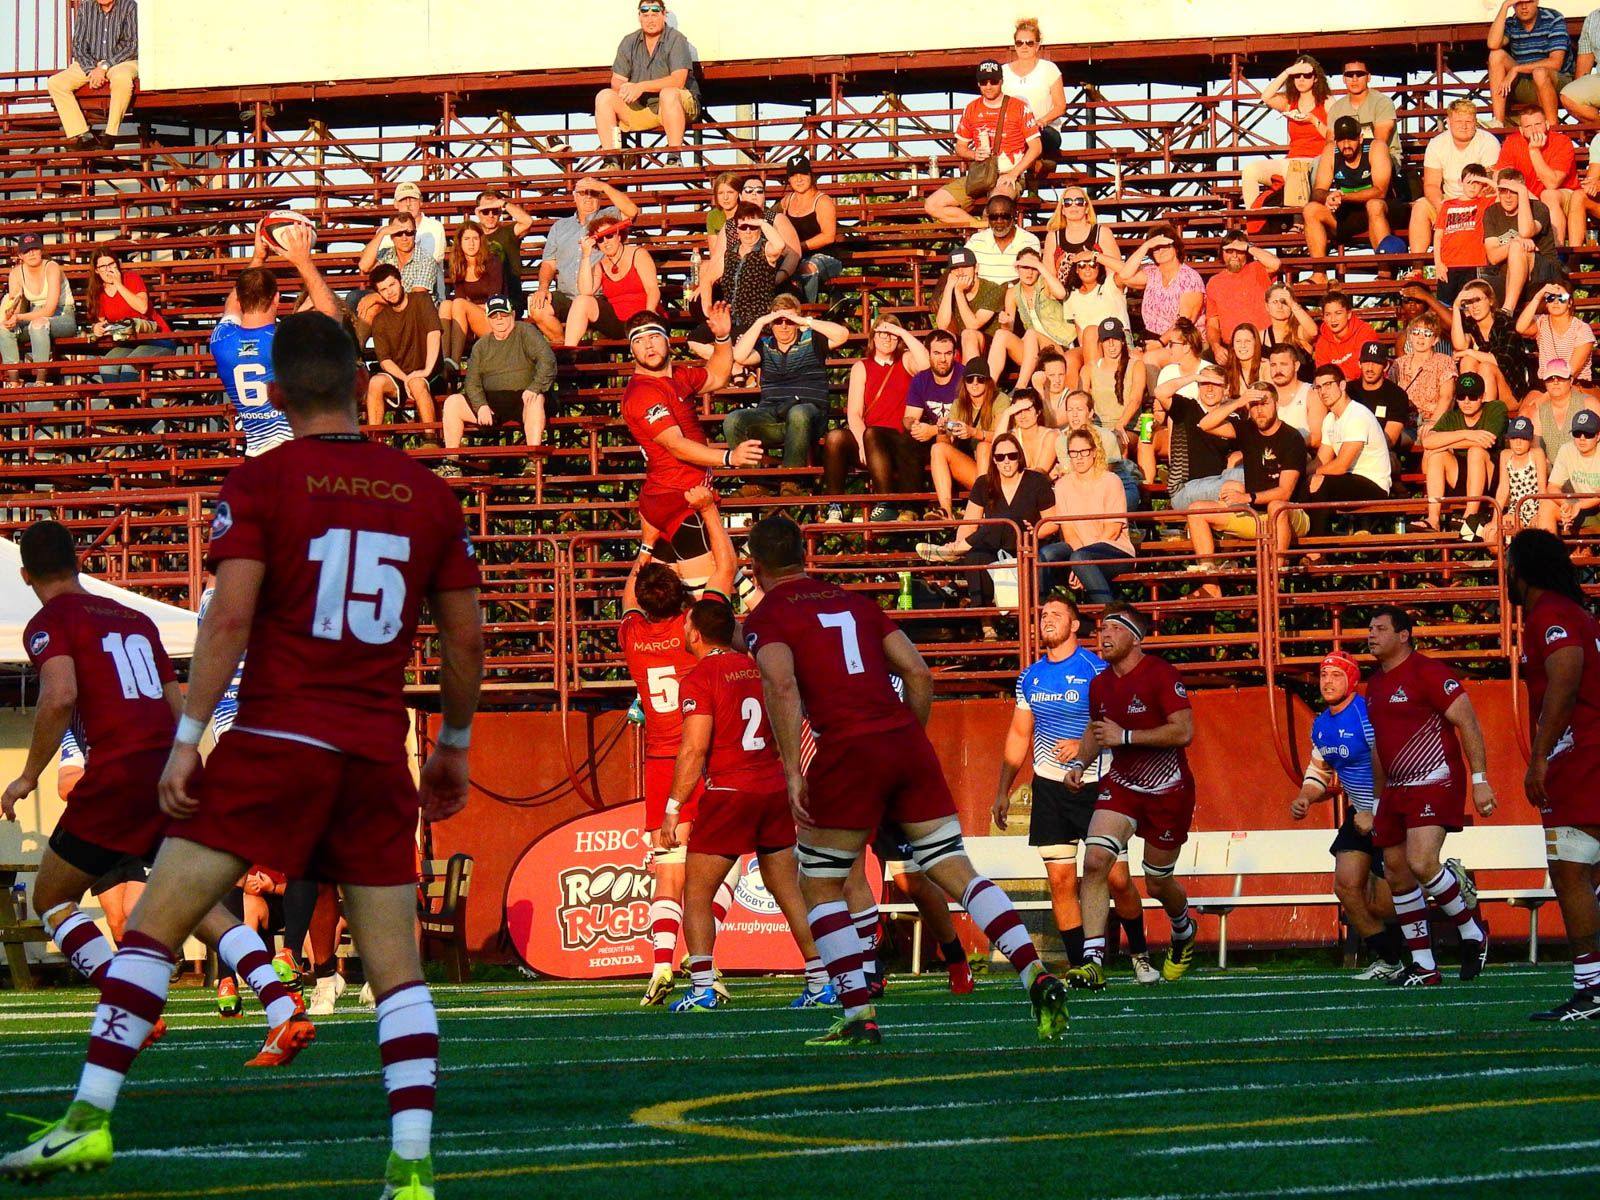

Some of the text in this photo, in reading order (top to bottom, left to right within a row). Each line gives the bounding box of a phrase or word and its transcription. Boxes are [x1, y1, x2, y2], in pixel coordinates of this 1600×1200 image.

[233, 363, 268, 406] 6
[240, 410, 283, 420] HODGSO
[306, 475, 412, 503] MARCO
[308, 528, 410, 644] 15
[634, 638, 680, 651] MARCO
[817, 610, 865, 675] 7
[101, 632, 163, 699] 10
[724, 669, 762, 683] MARCO
[647, 665, 680, 713] 5
[1030, 692, 1062, 703] Allianz
[741, 697, 766, 751] 2
[574, 828, 639, 853] HSBC
[735, 885, 765, 908] RUGBY
[563, 902, 652, 944] RUGB
[588, 954, 644, 968] HONDA
